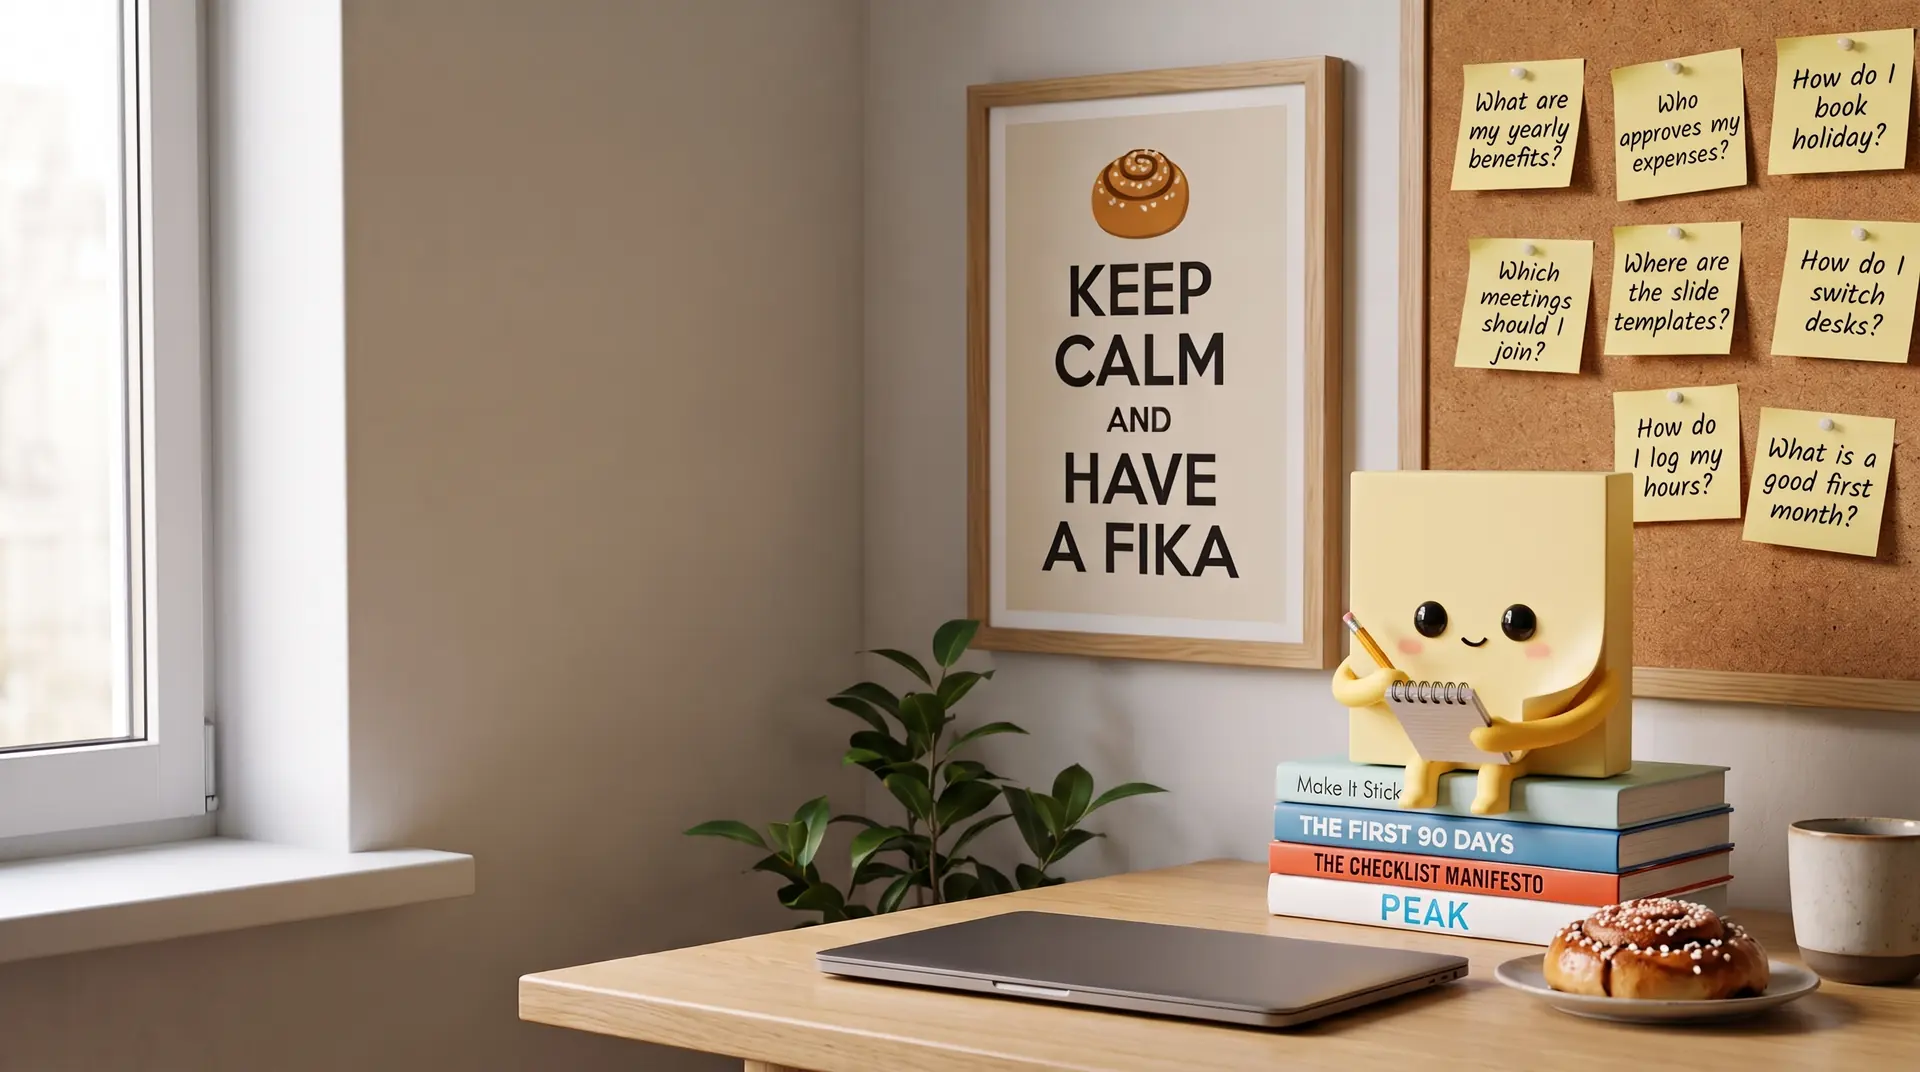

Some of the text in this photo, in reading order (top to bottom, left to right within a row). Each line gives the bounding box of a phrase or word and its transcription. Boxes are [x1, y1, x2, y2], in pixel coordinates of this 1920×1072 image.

[1792, 62, 1896, 90] How do I
[1475, 89, 1569, 113] What are
[1658, 90, 1699, 114] Who
[1814, 92, 1868, 119] book
[1469, 116, 1570, 147] my yearly
[1619, 115, 1741, 153] approves my
[1792, 122, 1887, 154] holiday?
[1468, 145, 1562, 169] benefits?
[1632, 140, 1729, 176] expenses?
[1499, 260, 1560, 282] Which
[1624, 251, 1730, 274] Where are
[1800, 249, 1905, 276] How do I
[1069, 260, 1212, 318] KEEP
[1480, 288, 1573, 316] meetings
[1628, 278, 1720, 302] the slide
[1809, 282, 1885, 306] switch
[1481, 311, 1564, 337] should I
[1614, 307, 1730, 338] templates?
[1805, 309, 1884, 337] desks?
[1054, 332, 1224, 388] CALM
[1489, 341, 1546, 366] join?
[1106, 406, 1172, 433] AND
[1637, 411, 1717, 439] How do
[1634, 445, 1723, 474] I log my
[1768, 436, 1877, 468] What is a
[1064, 451, 1217, 507] HAVE
[1643, 472, 1713, 498] hours?
[1762, 469, 1874, 499] good first
[1770, 502, 1859, 528] month?
[1041, 520, 1240, 579] A FIKA
[1297, 775, 1402, 801] Make It Stick
[1299, 814, 1514, 855] THE FIRST 90 DAYS
[1313, 852, 1543, 894] THE CHECKLIST MANIFESTO
[1381, 893, 1470, 931] PEAK
